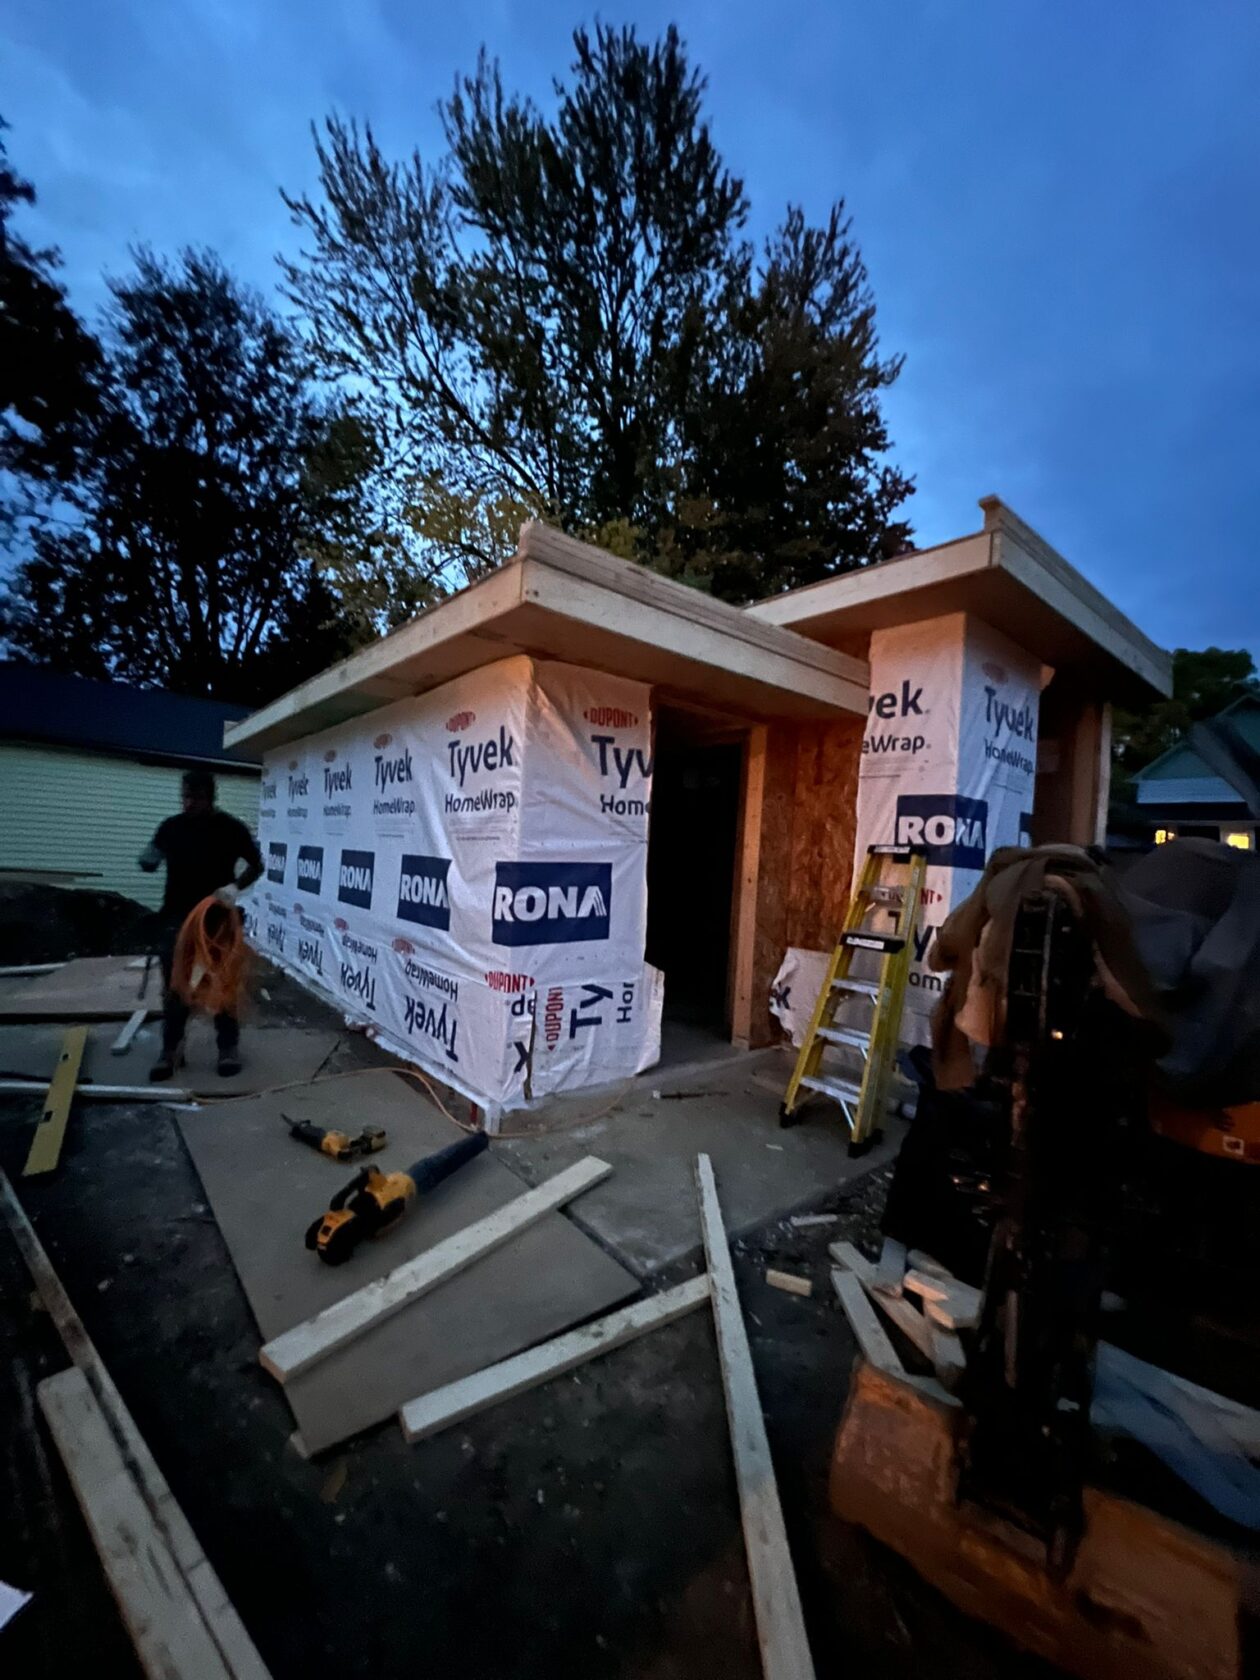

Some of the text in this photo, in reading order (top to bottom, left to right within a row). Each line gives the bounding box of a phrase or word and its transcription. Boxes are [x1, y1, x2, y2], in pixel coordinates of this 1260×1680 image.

[589, 707, 634, 728] DUPONT
[984, 685, 1034, 742] Tyvek
[374, 748, 413, 794] Tyvek
[448, 725, 513, 787] Tyvek
[984, 738, 1034, 776] HomeWrap
[323, 762, 352, 800] Tyvek
[373, 797, 416, 817] HomeWrap
[445, 788, 515, 813] HomeWrap
[897, 815, 985, 849] RONA
[340, 865, 372, 891] RONA
[400, 873, 449, 909] RONA
[494, 885, 607, 922] RONA
[341, 962, 376, 1010] Tyvek
[405, 959, 458, 1002] HomeWrap
[488, 971, 528, 994] DUPONT
[404, 995, 458, 1062] Tyvek
[569, 984, 613, 1039] Ty
